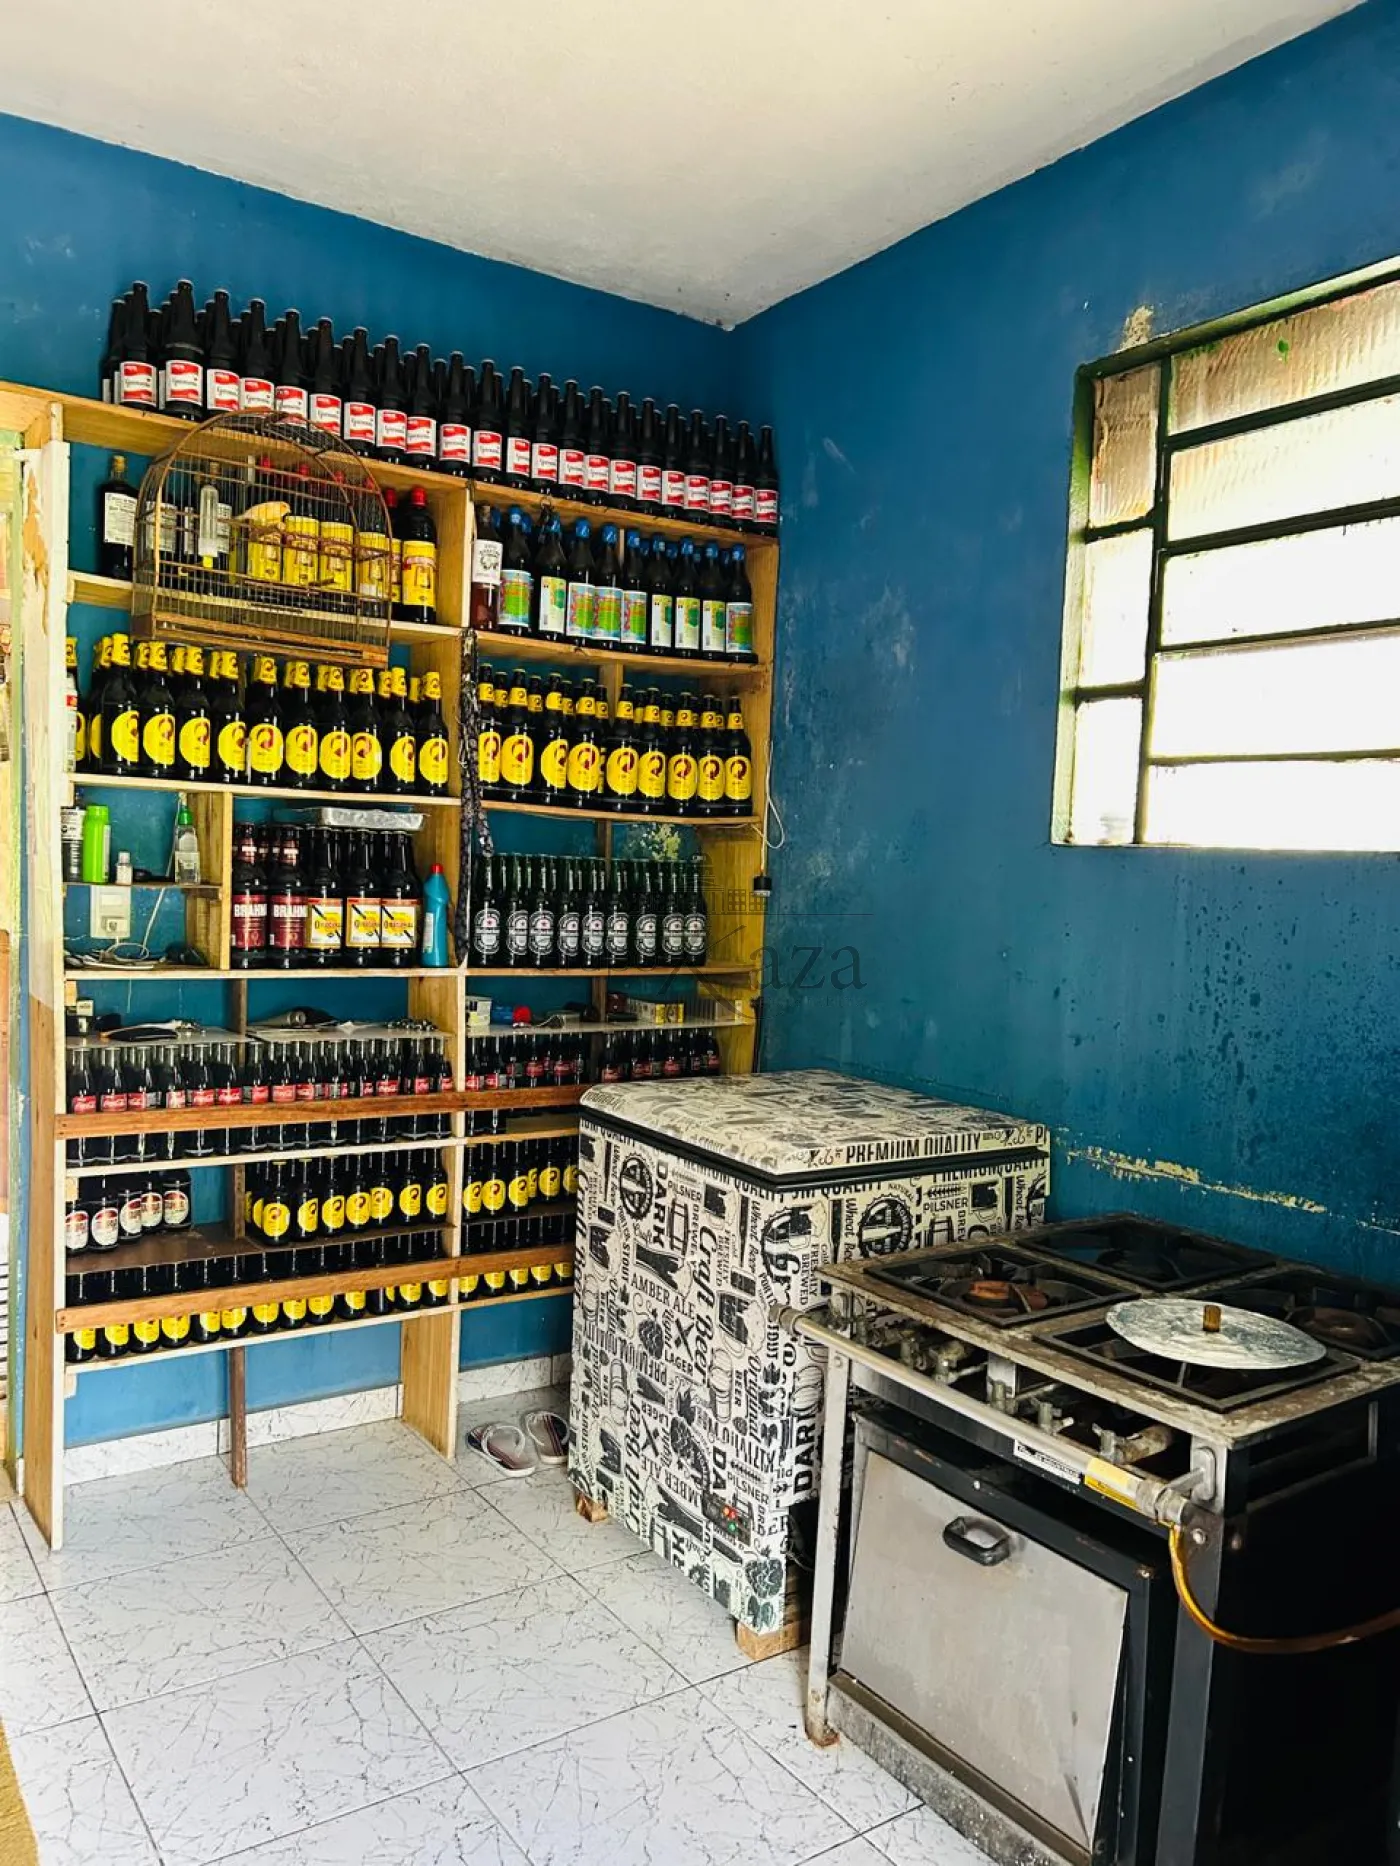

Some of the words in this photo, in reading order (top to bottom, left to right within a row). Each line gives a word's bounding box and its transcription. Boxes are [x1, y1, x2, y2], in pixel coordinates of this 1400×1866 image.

[846, 1140, 920, 1164] PREMIUM
[924, 1132, 981, 1156] QUALITY
[653, 1160, 669, 1248] DARK
[667, 1180, 702, 1202] PILSNER
[922, 1197, 969, 1213] PILSNER
[845, 1198, 857, 1239] Wheat
[621, 1243, 630, 1283] STOUT
[693, 1226, 717, 1308] Craft
[800, 1254, 809, 1305] BREWED
[631, 1273, 670, 1306] AMBER
[673, 1295, 695, 1320] ALE
[665, 1350, 693, 1376] LAGER
[694, 1314, 713, 1384] Beer
[735, 1370, 743, 1407] BEER
[625, 1393, 640, 1459] Beer
[727, 1471, 769, 1504] PILSNER
